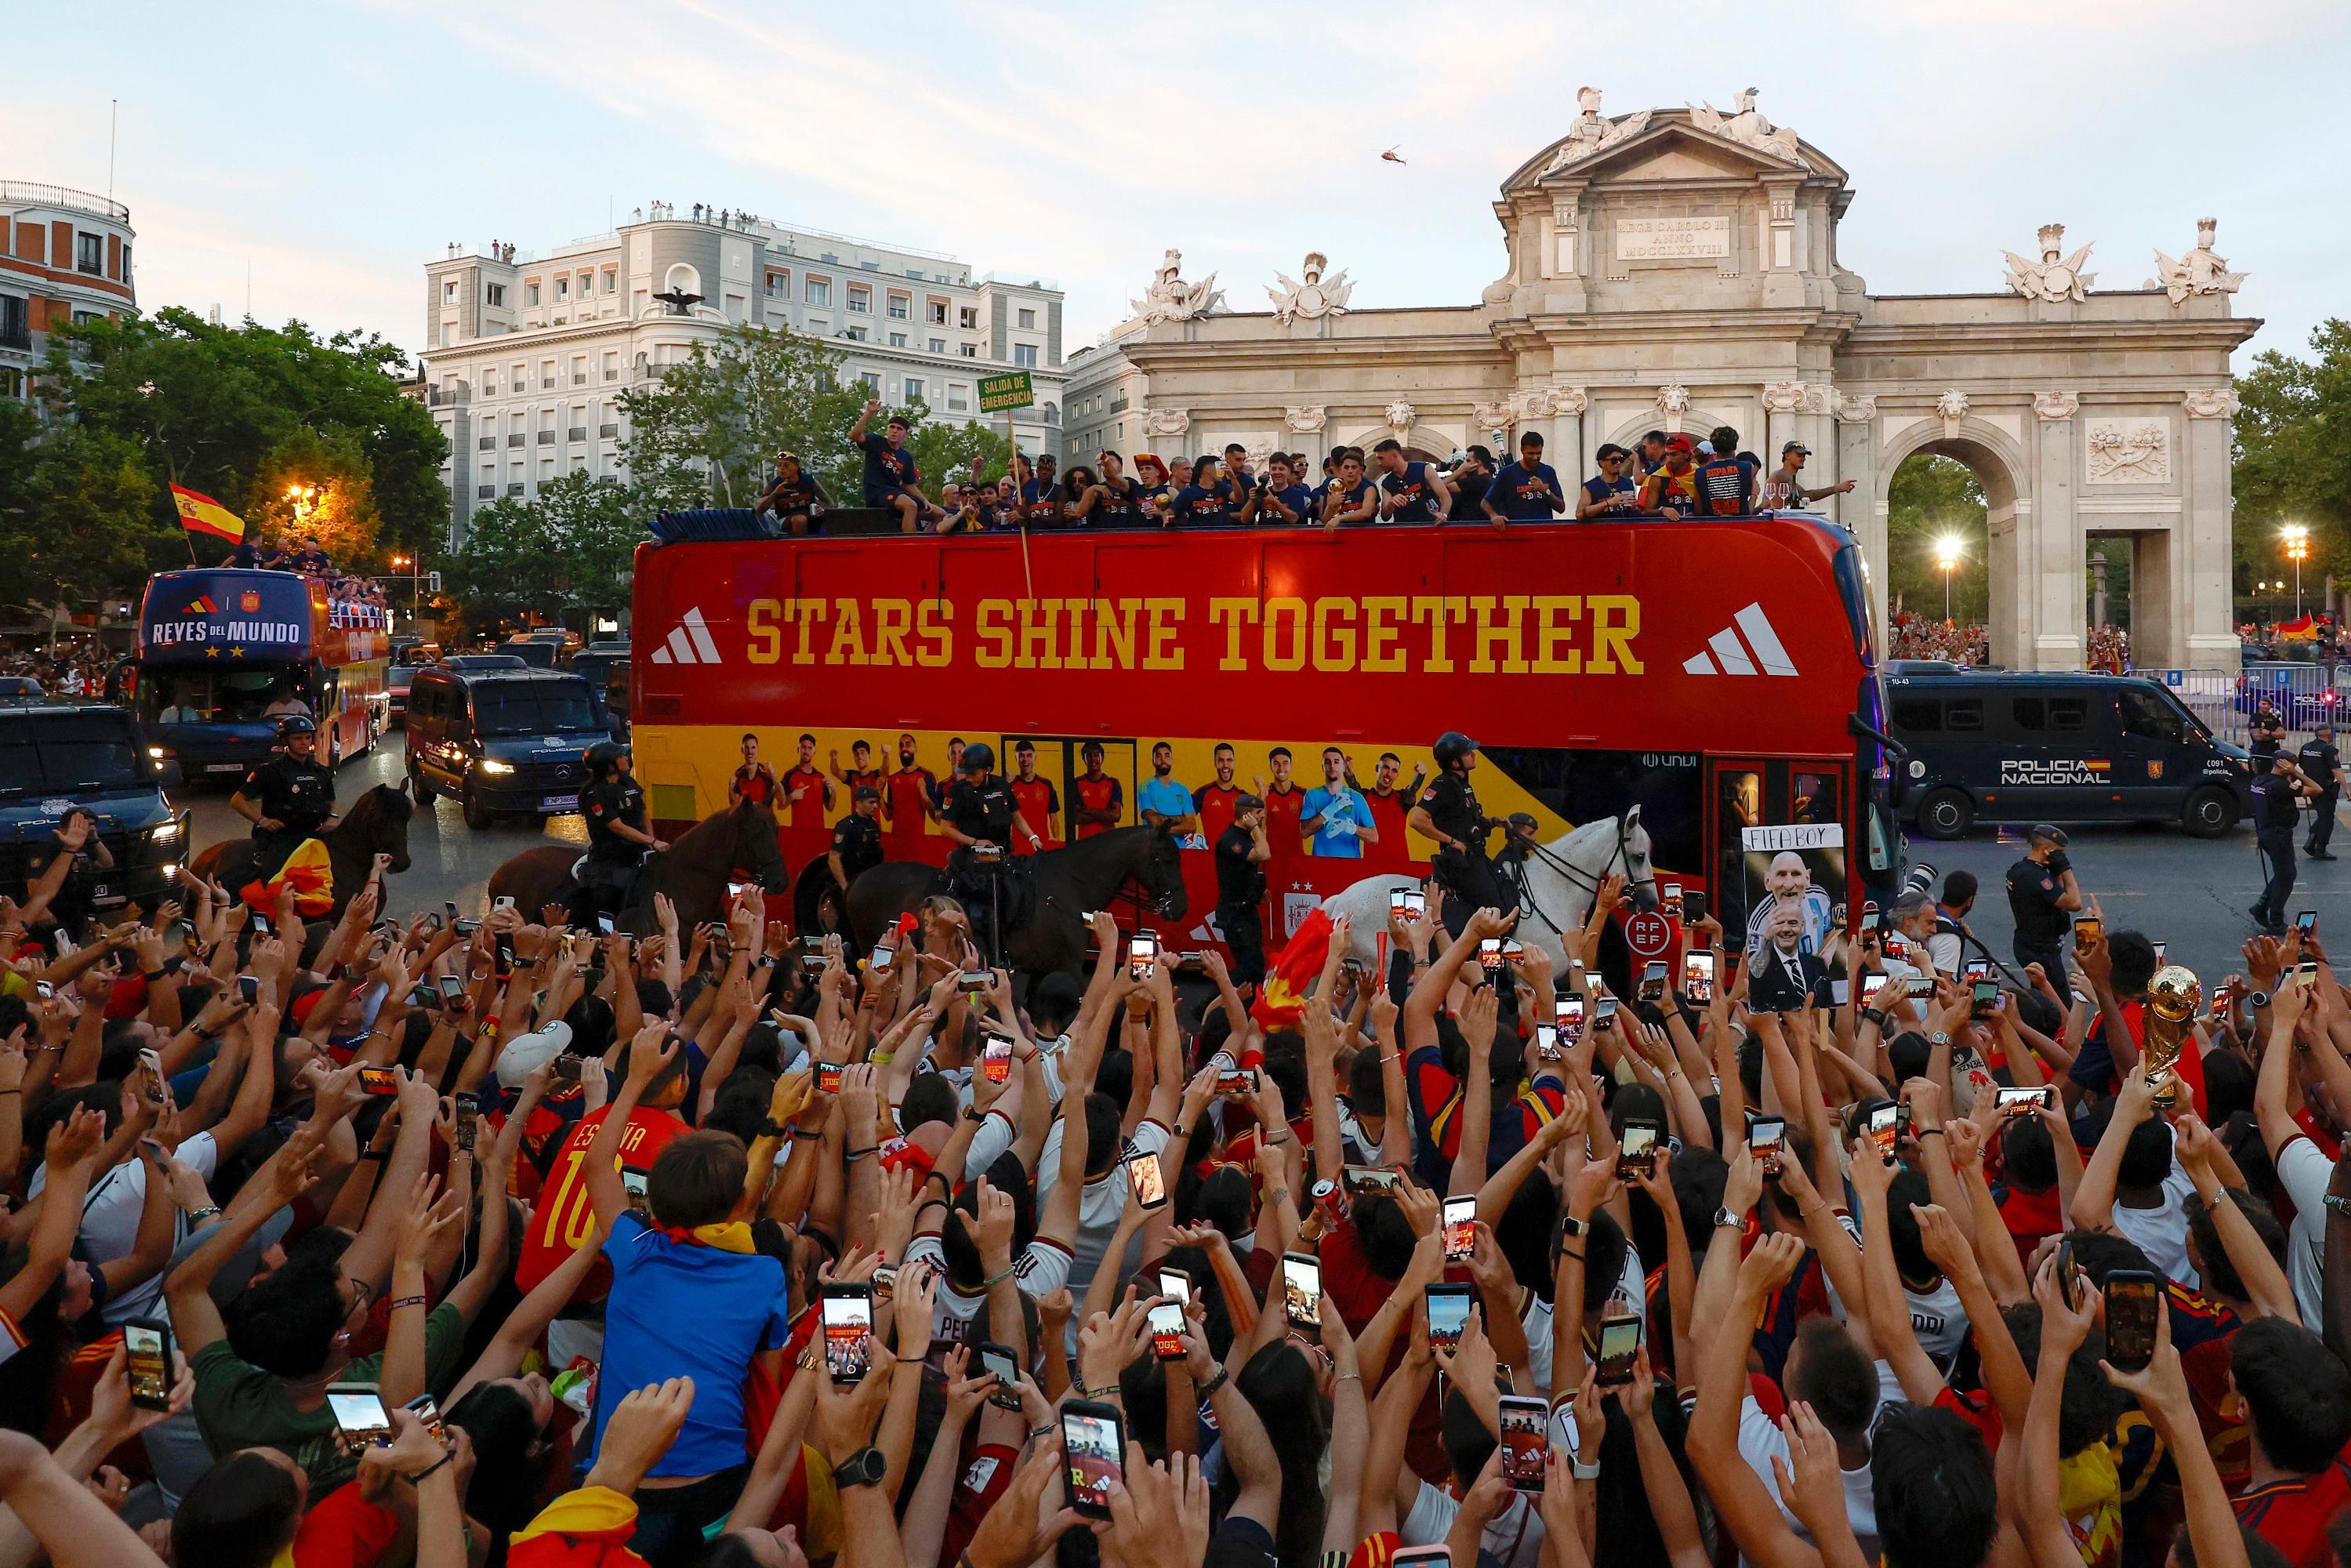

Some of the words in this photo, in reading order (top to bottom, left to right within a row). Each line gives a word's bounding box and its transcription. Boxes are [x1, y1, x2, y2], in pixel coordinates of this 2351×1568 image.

[1617, 223, 1652, 233] REGE
[1656, 220, 1711, 232] CAROLO
[1714, 220, 1730, 230] III
[1653, 234, 1694, 244] ANNO
[1624, 245, 1722, 256] MDCCLXXVIII
[984, 379, 1013, 394] SALIDA
[1014, 376, 1025, 389] DE
[981, 390, 1033, 409] EMERGENCIA
[153, 621, 206, 644] REYES
[209, 625, 226, 636] DEL
[227, 621, 300, 644] MUNDO
[747, 597, 954, 669] STARS
[975, 597, 1185, 670] SHINE
[1210, 594, 1645, 675] TOGETHER
[2001, 772, 2111, 785] NACIONAL
[1751, 828, 1792, 849] FIFA
[1795, 827, 1826, 848] BOY
[573, 1121, 648, 1152] ESÑA
[542, 1150, 622, 1249] 10
